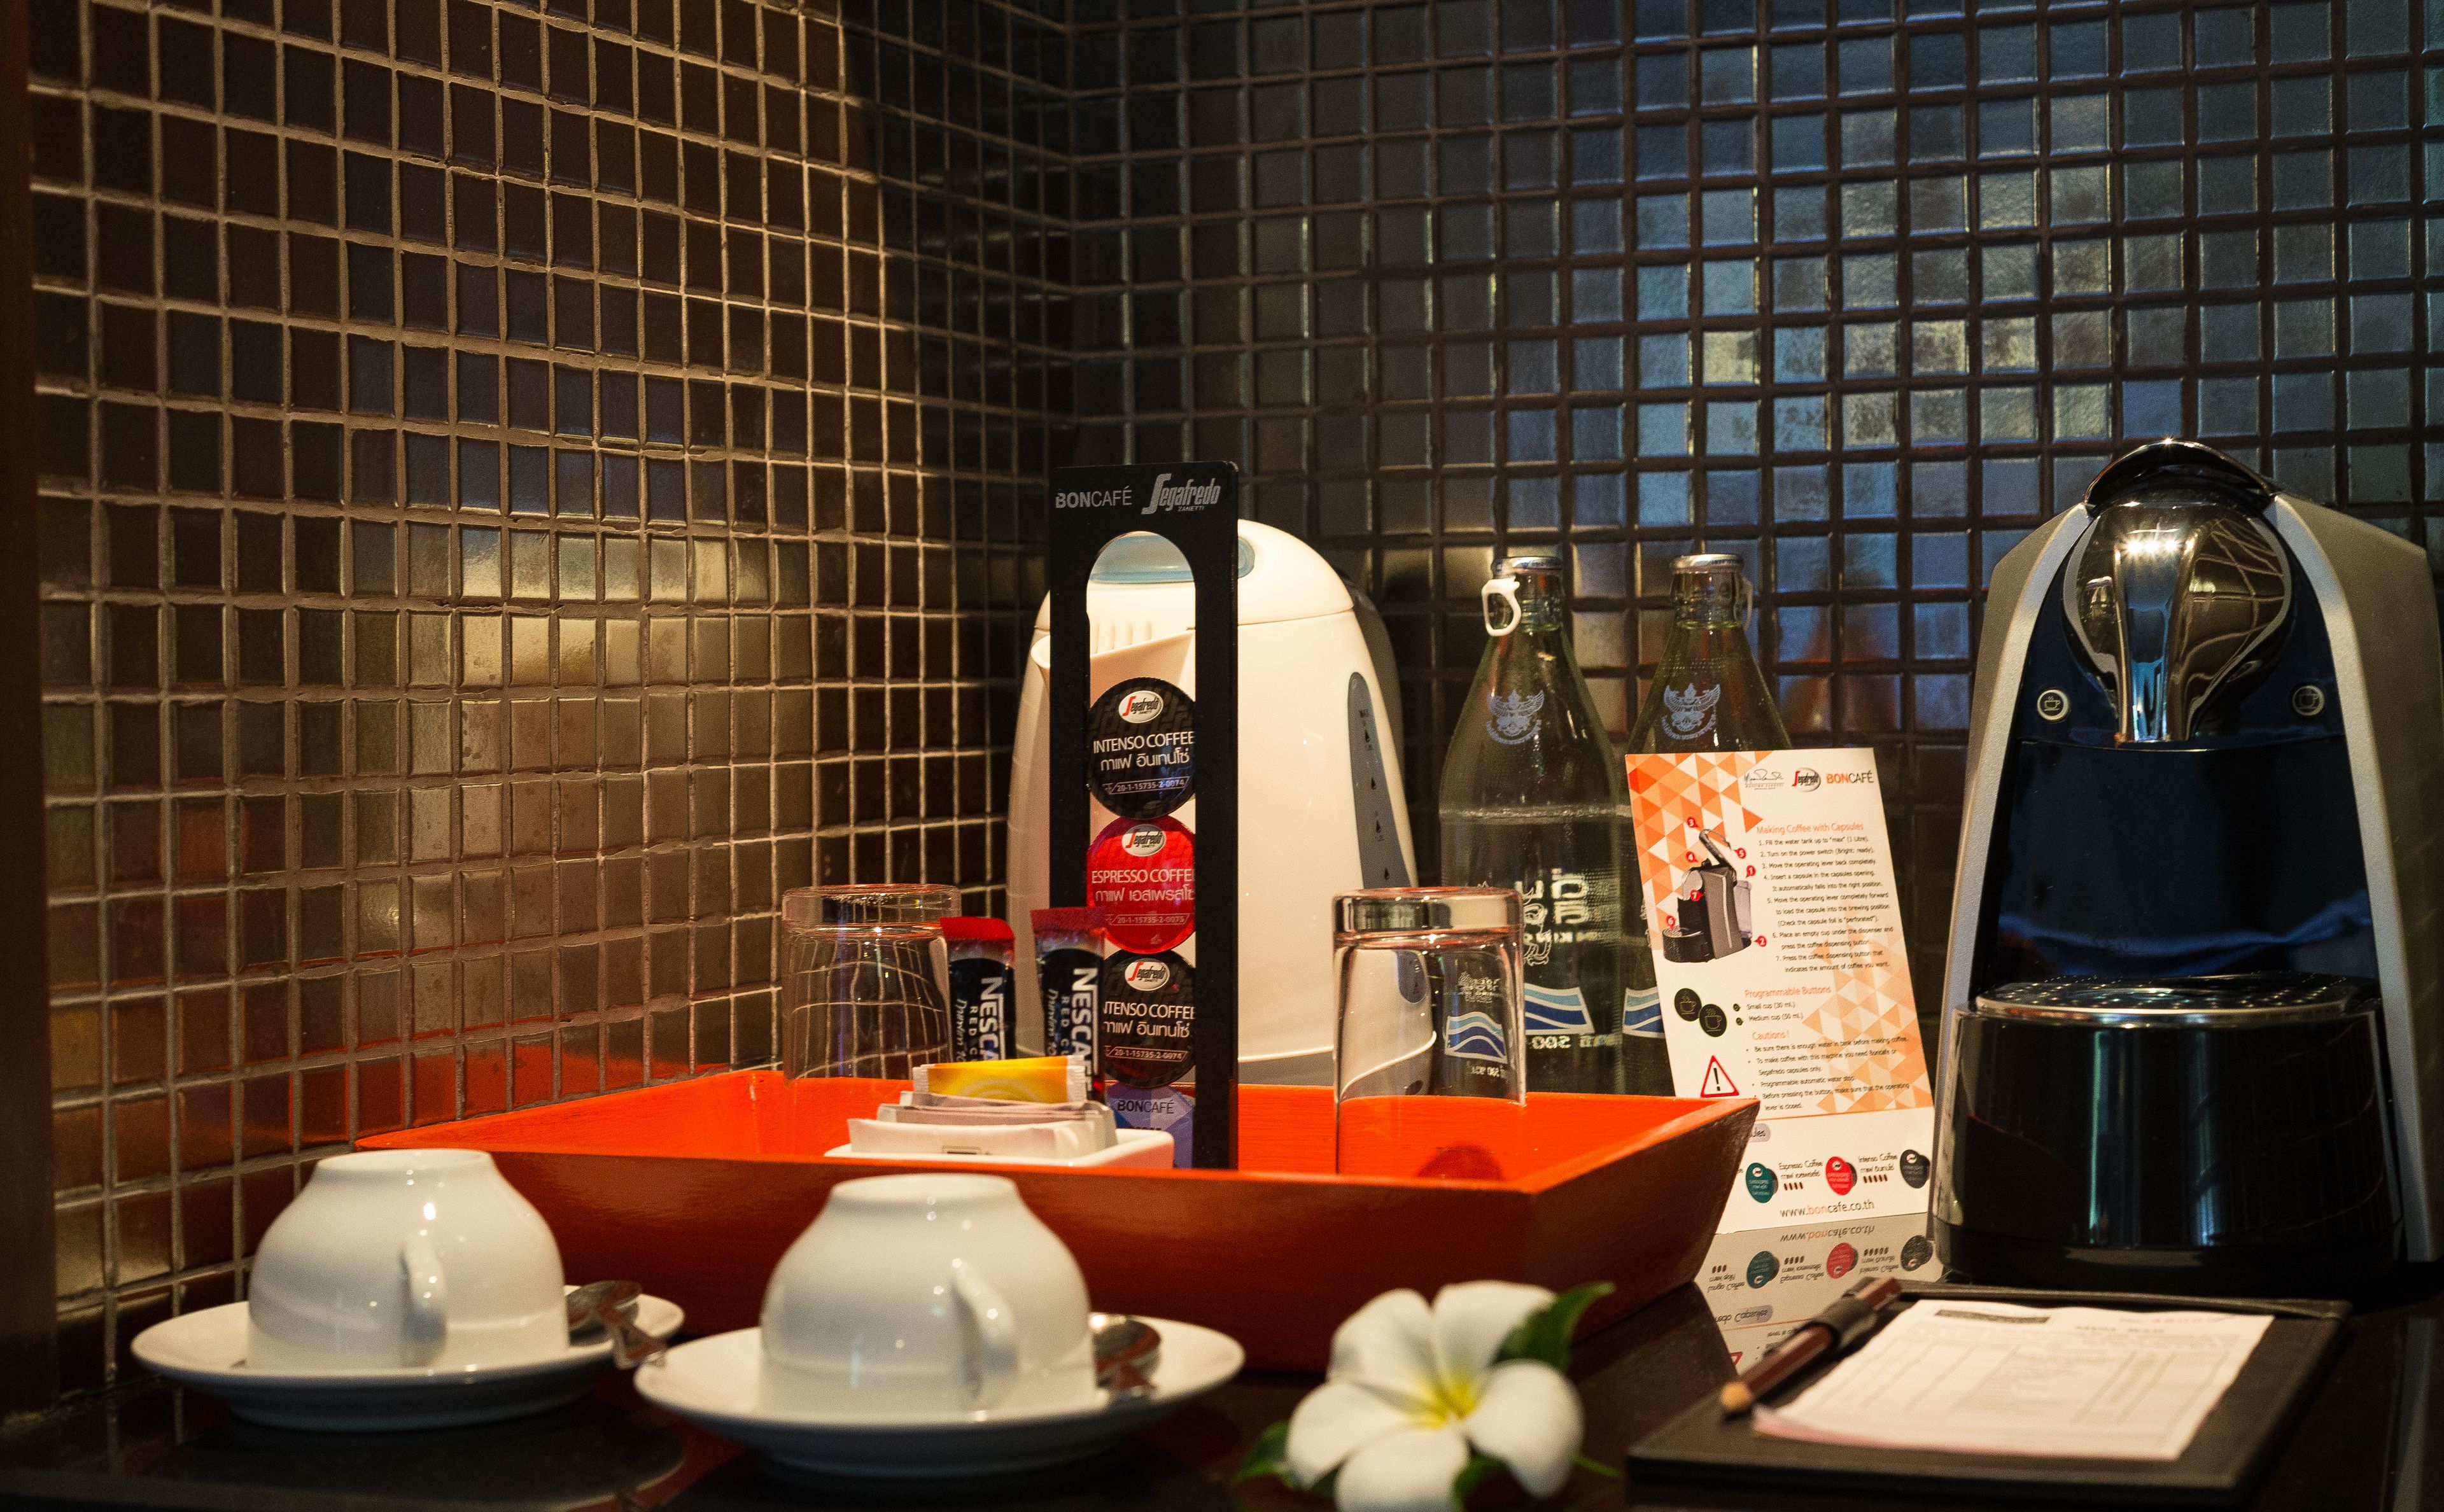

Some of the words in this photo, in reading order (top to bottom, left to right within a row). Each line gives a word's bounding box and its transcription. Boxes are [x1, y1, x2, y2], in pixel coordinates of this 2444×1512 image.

[1055, 485, 1132, 508] BONCAFÉ
[1141, 473, 1221, 514] Segafredo
[1093, 735, 1144, 754] INTENSO
[1146, 731, 1195, 748] COFFEE
[1100, 753, 1132, 771] กาแฟ
[1827, 771, 1874, 784] BONCAFÉ
[1831, 822, 1864, 833] Capsules
[1092, 869, 1148, 884] ESPRESSO
[1149, 869, 1195, 882] COFFE
[1095, 887, 1125, 902] กาแฟ
[1745, 988, 1800, 999] Programmable
[1060, 996, 1070, 1028] RED
[969, 1005, 978, 1036] RED
[1752, 1031, 1786, 1040] Cautions
[1118, 1099, 1174, 1114] BONCAFÉ
[1780, 1199, 1874, 1217] www.boncafe.co.th
